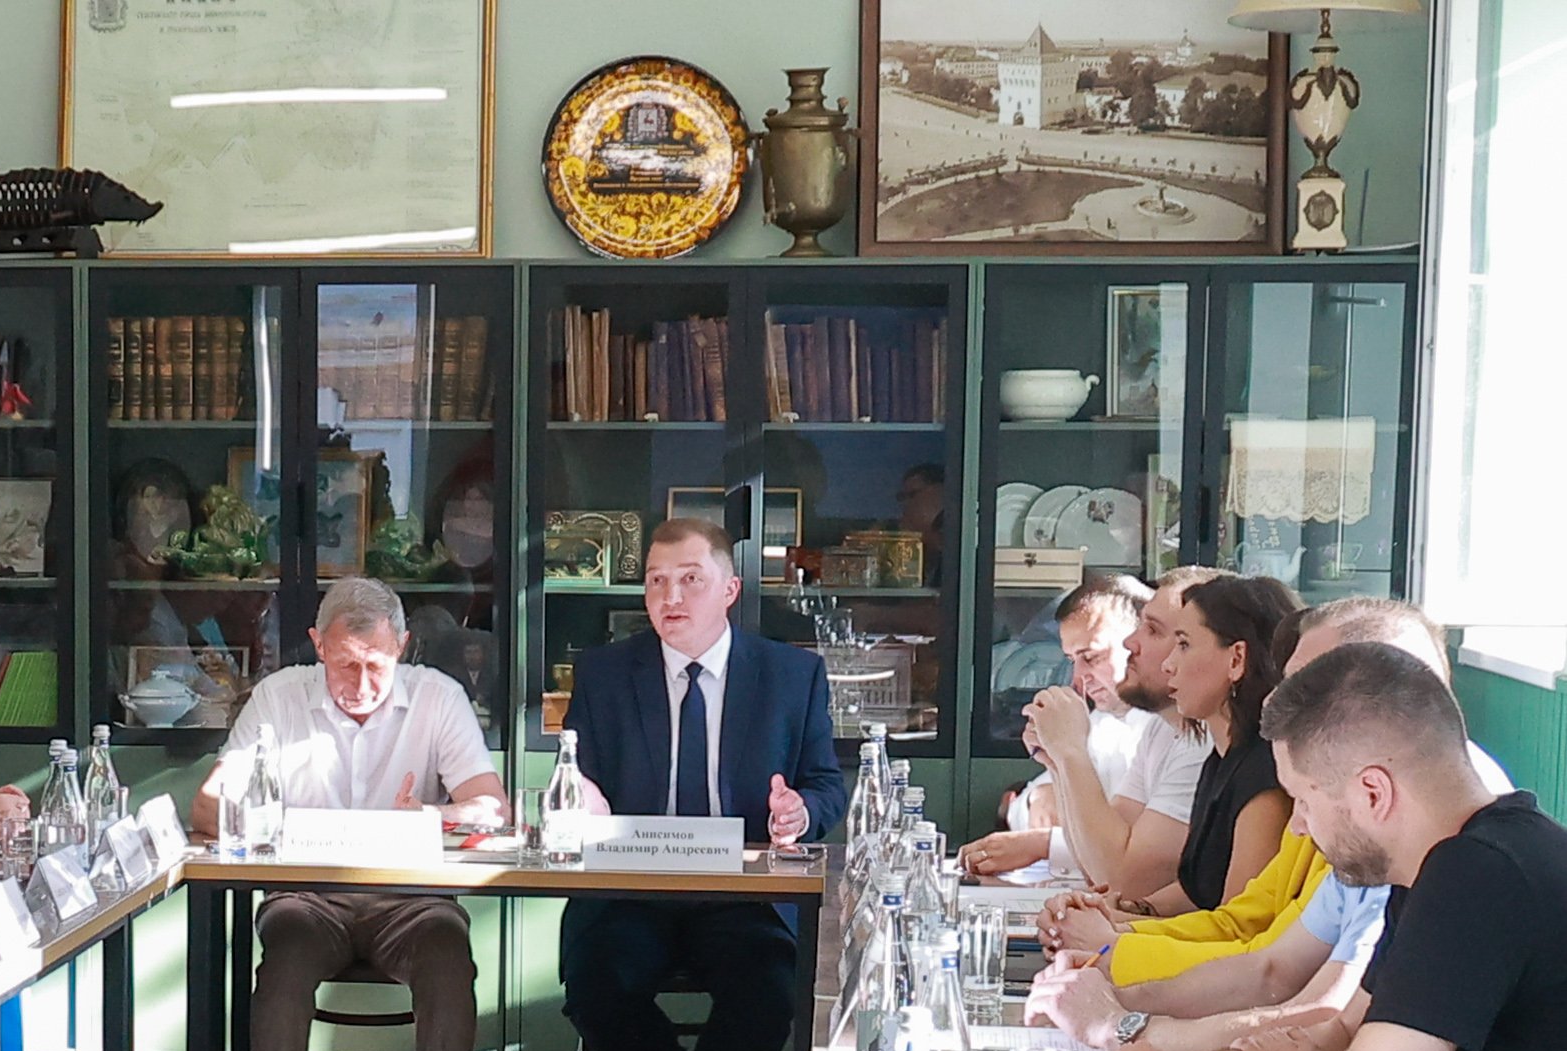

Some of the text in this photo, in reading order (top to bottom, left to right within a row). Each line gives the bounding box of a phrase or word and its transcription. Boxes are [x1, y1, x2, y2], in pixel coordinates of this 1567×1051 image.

[631, 829, 695, 840] Анисимов
[595, 842, 730, 856] Владимир Андреевич
